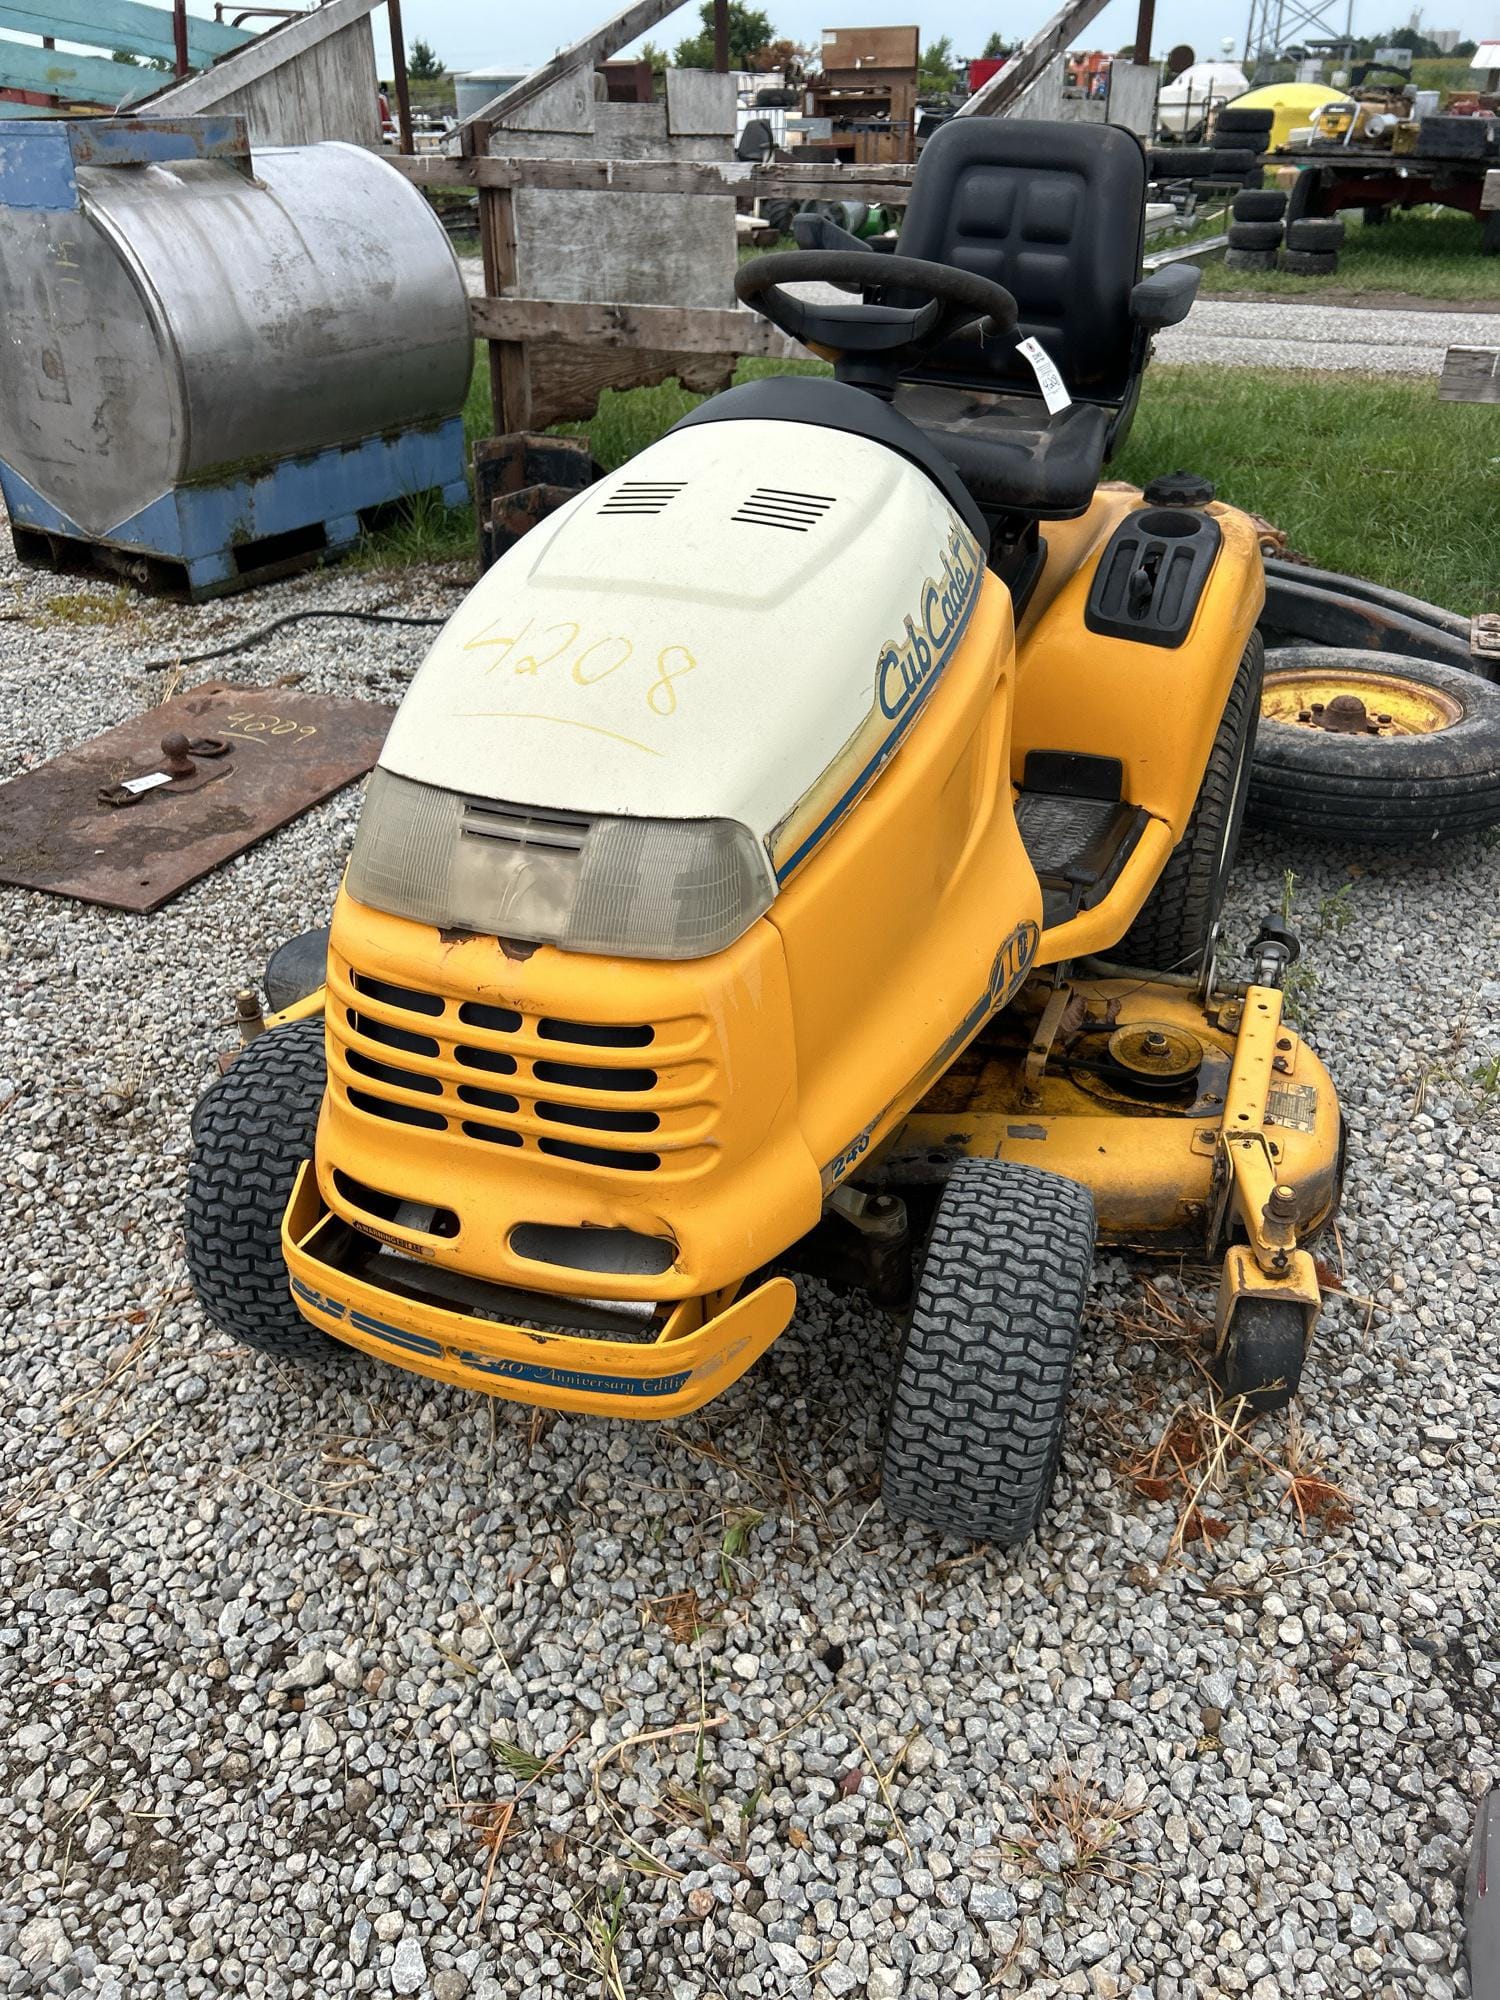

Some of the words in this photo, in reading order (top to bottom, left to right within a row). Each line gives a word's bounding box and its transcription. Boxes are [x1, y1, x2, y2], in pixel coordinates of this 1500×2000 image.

[879, 623, 932, 720] Cub
[926, 538, 974, 650] Cadet
[463, 617, 697, 717] 4208
[227, 711, 318, 745] 4209
[533, 1367, 635, 1394] Anniversary
